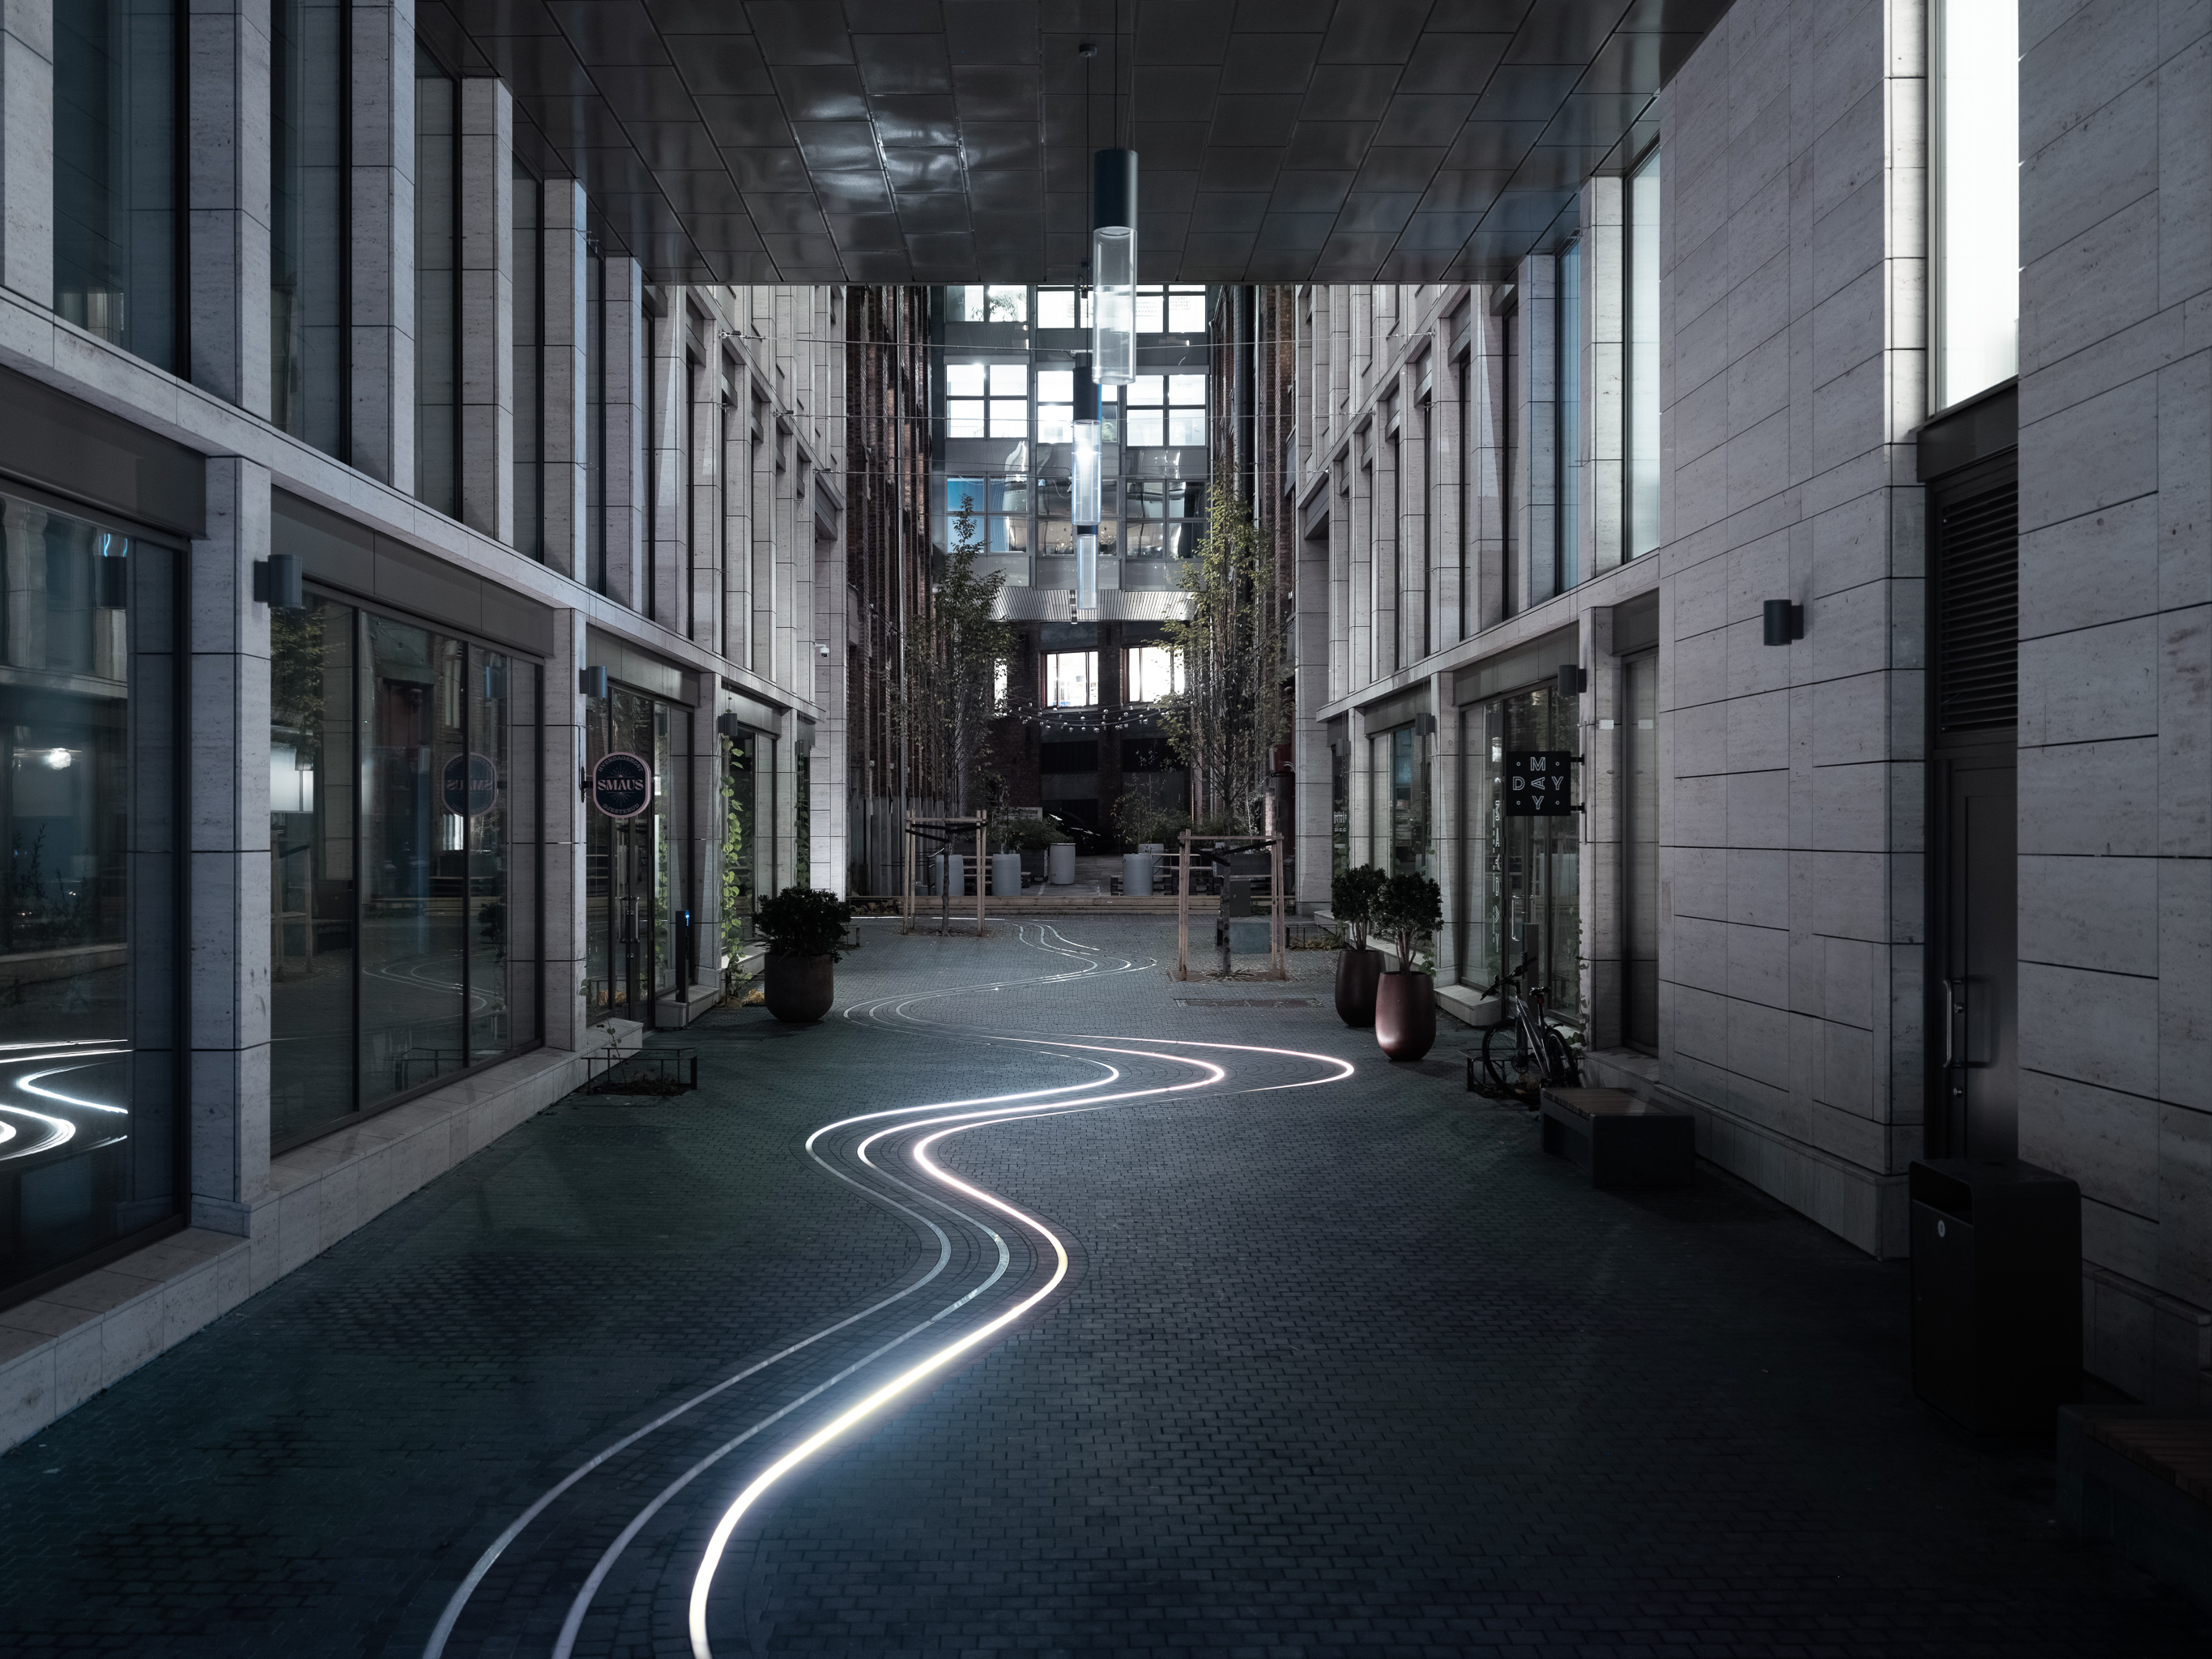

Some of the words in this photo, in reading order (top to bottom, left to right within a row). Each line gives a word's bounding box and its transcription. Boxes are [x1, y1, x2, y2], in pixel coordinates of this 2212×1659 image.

[598, 756, 644, 772] HVERDAGSKOST
[597, 779, 644, 791] SMAUS
[1512, 776, 1564, 791] DAY
[603, 803, 640, 814] GJESTEBUD
